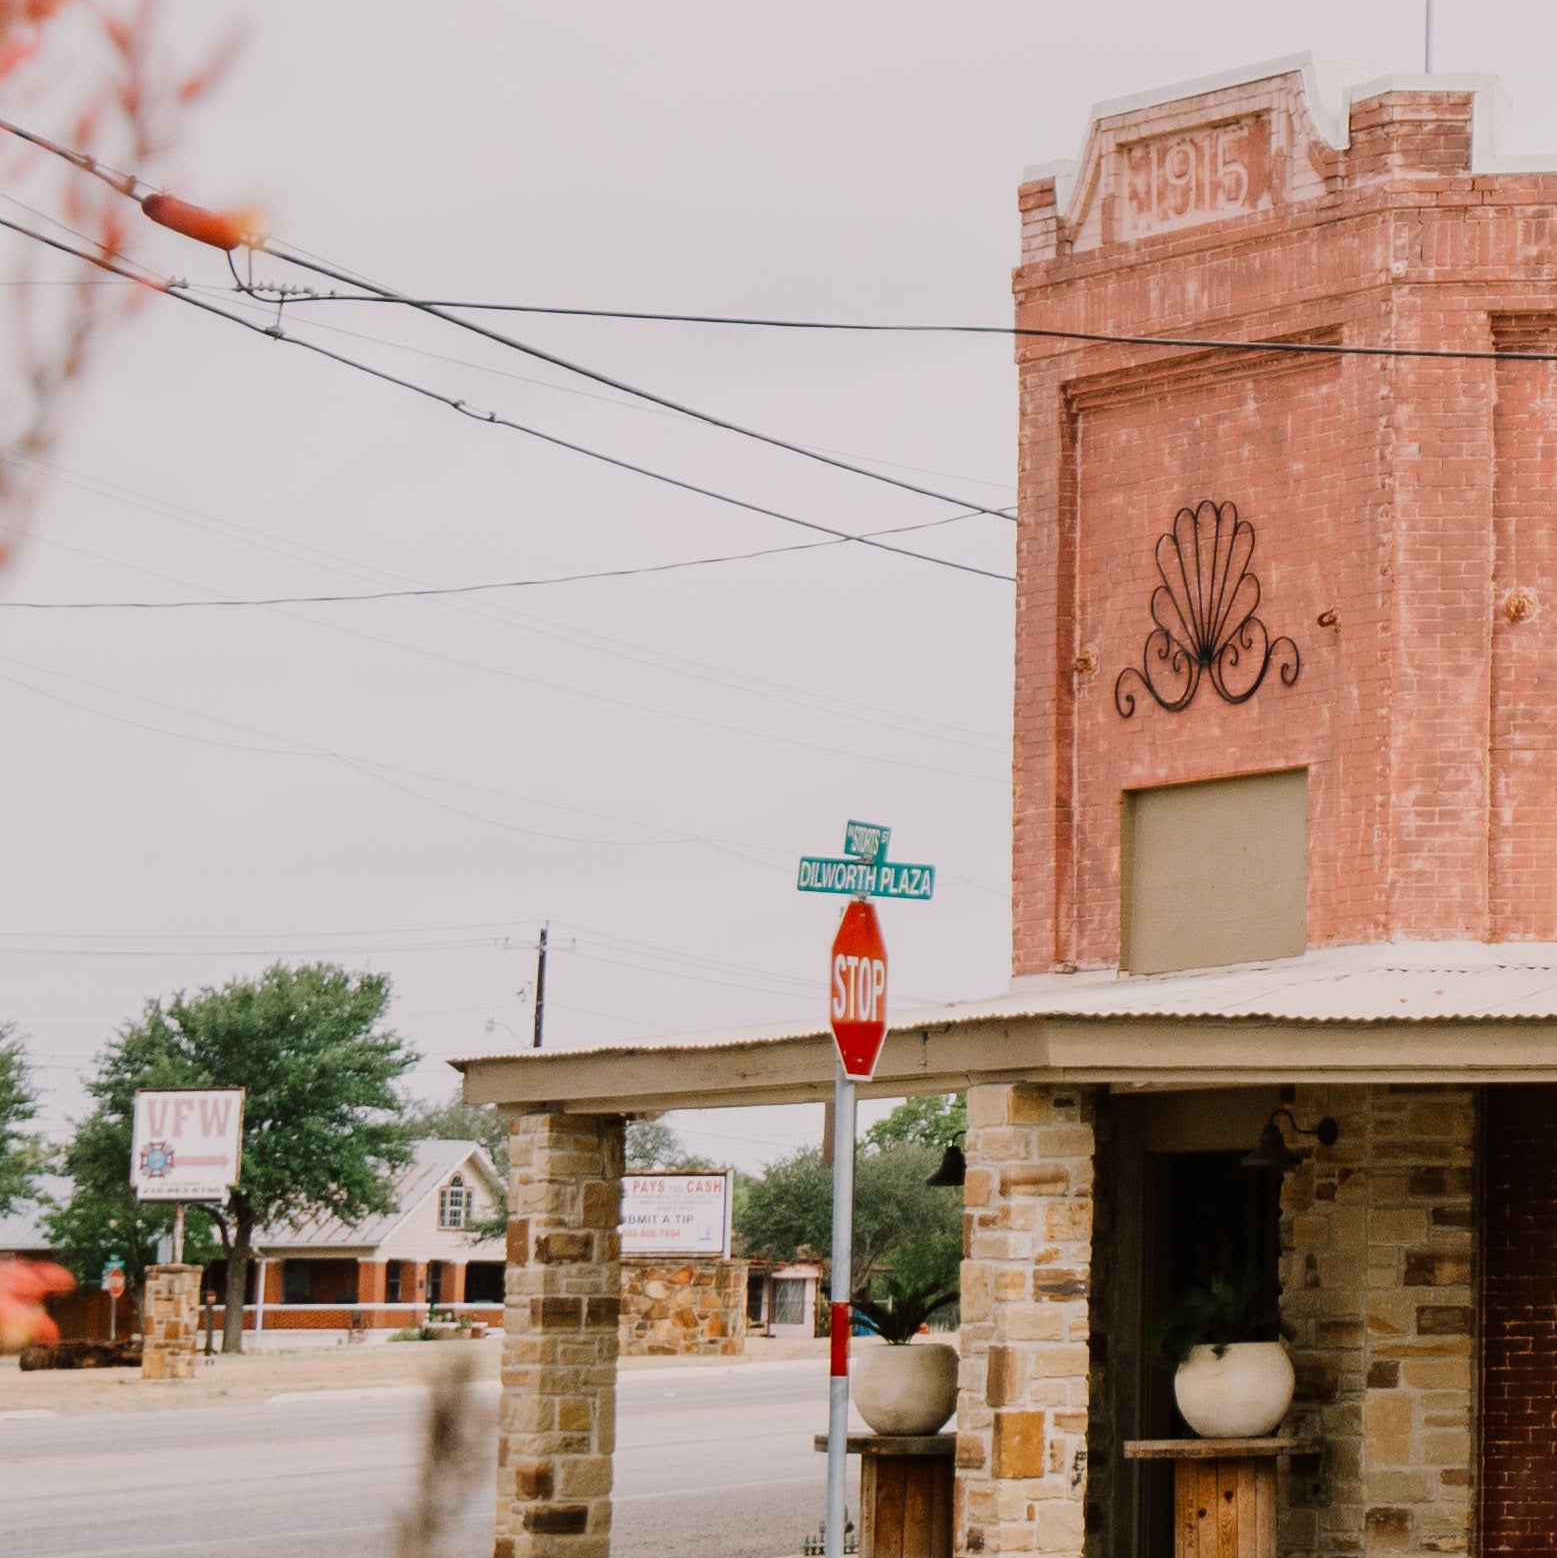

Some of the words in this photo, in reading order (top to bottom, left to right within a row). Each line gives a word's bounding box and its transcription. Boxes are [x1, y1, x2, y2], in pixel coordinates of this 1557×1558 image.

[1150, 126, 1249, 221] 1915
[799, 861, 878, 891] DILWORTH
[880, 866, 932, 896] PLAZA
[832, 953, 885, 1022] STOP
[146, 1098, 233, 1137] VFW
[632, 1180, 666, 1194] PAYS
[686, 1180, 722, 1194] CASH
[662, 1214, 671, 1224] A
[675, 1214, 695, 1224] TIP
